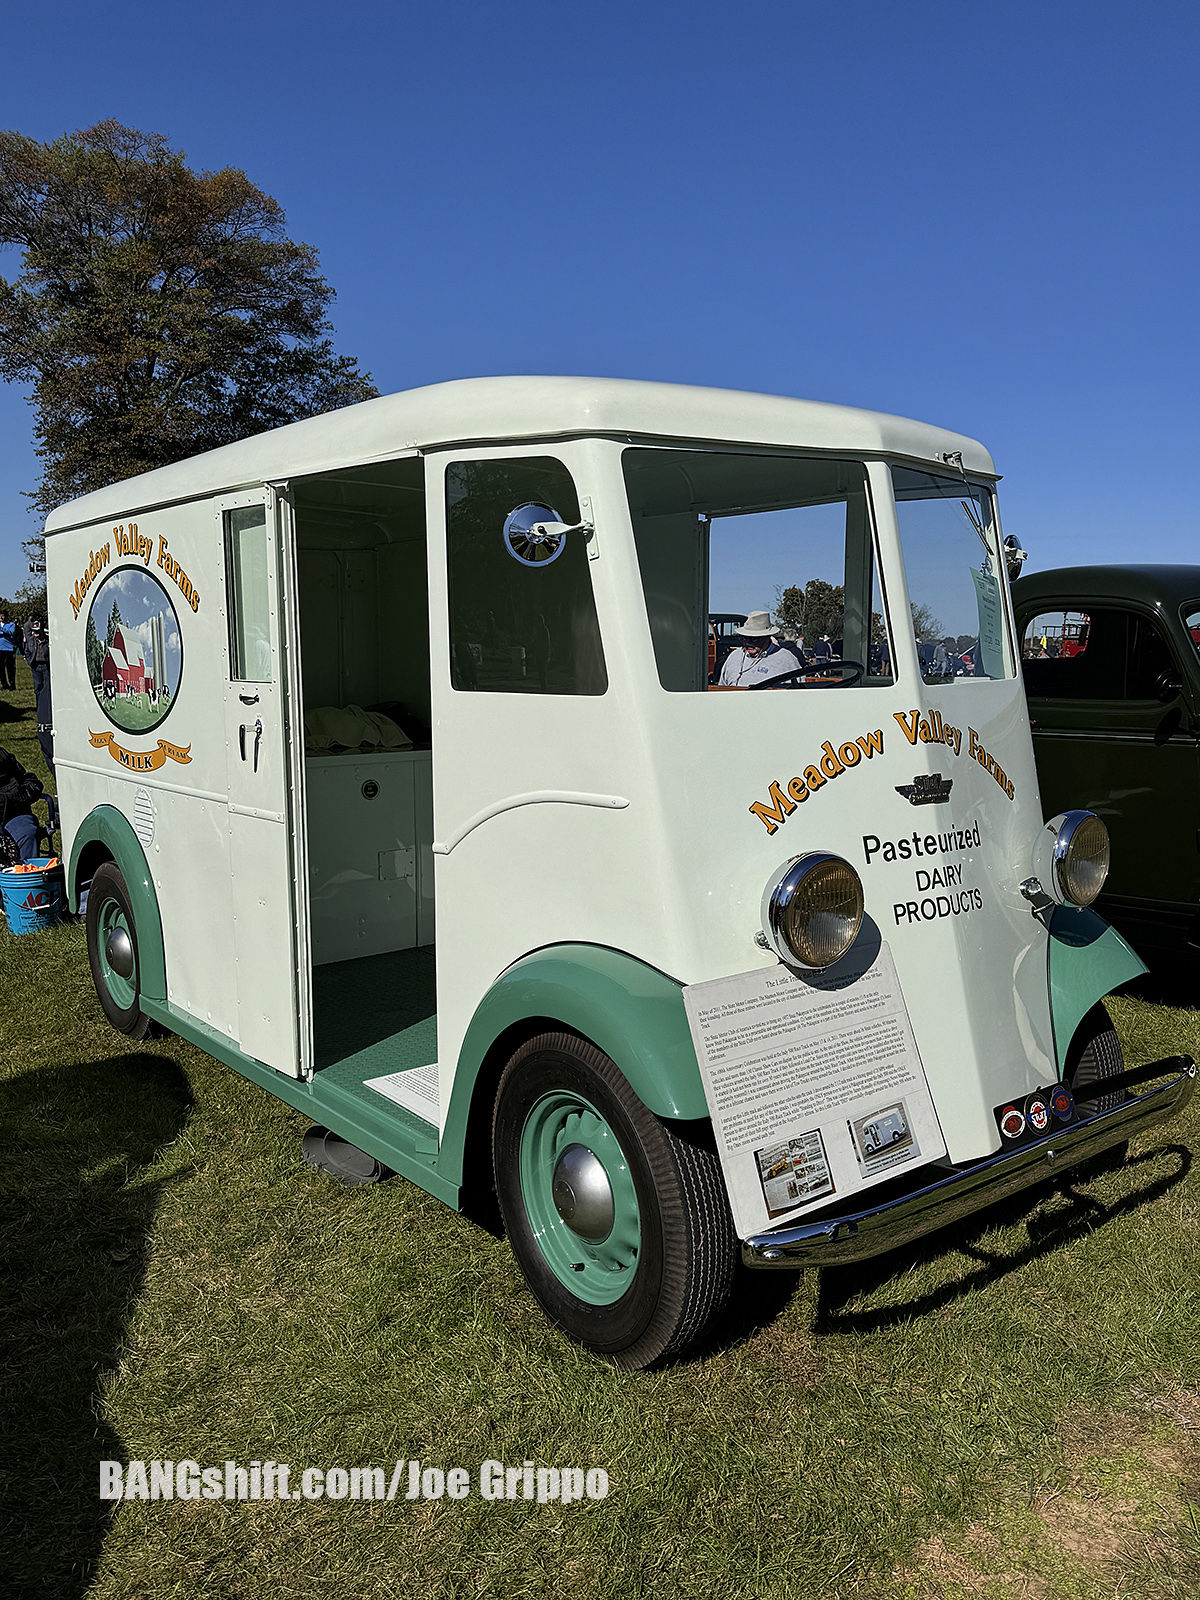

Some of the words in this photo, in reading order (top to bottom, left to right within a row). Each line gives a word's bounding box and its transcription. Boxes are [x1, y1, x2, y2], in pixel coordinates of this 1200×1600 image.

[69, 542, 111, 620] Meadow
[112, 522, 153, 566] Valley
[156, 533, 201, 614] Farms
[118, 749, 153, 769] MILK
[749, 729, 884, 836] Meadow
[893, 709, 963, 756] Valley
[967, 726, 1015, 800] Farms
[862, 820, 982, 864] Pasteurized
[916, 864, 963, 891] DAIRY
[893, 888, 983, 925] PRODUCTS
